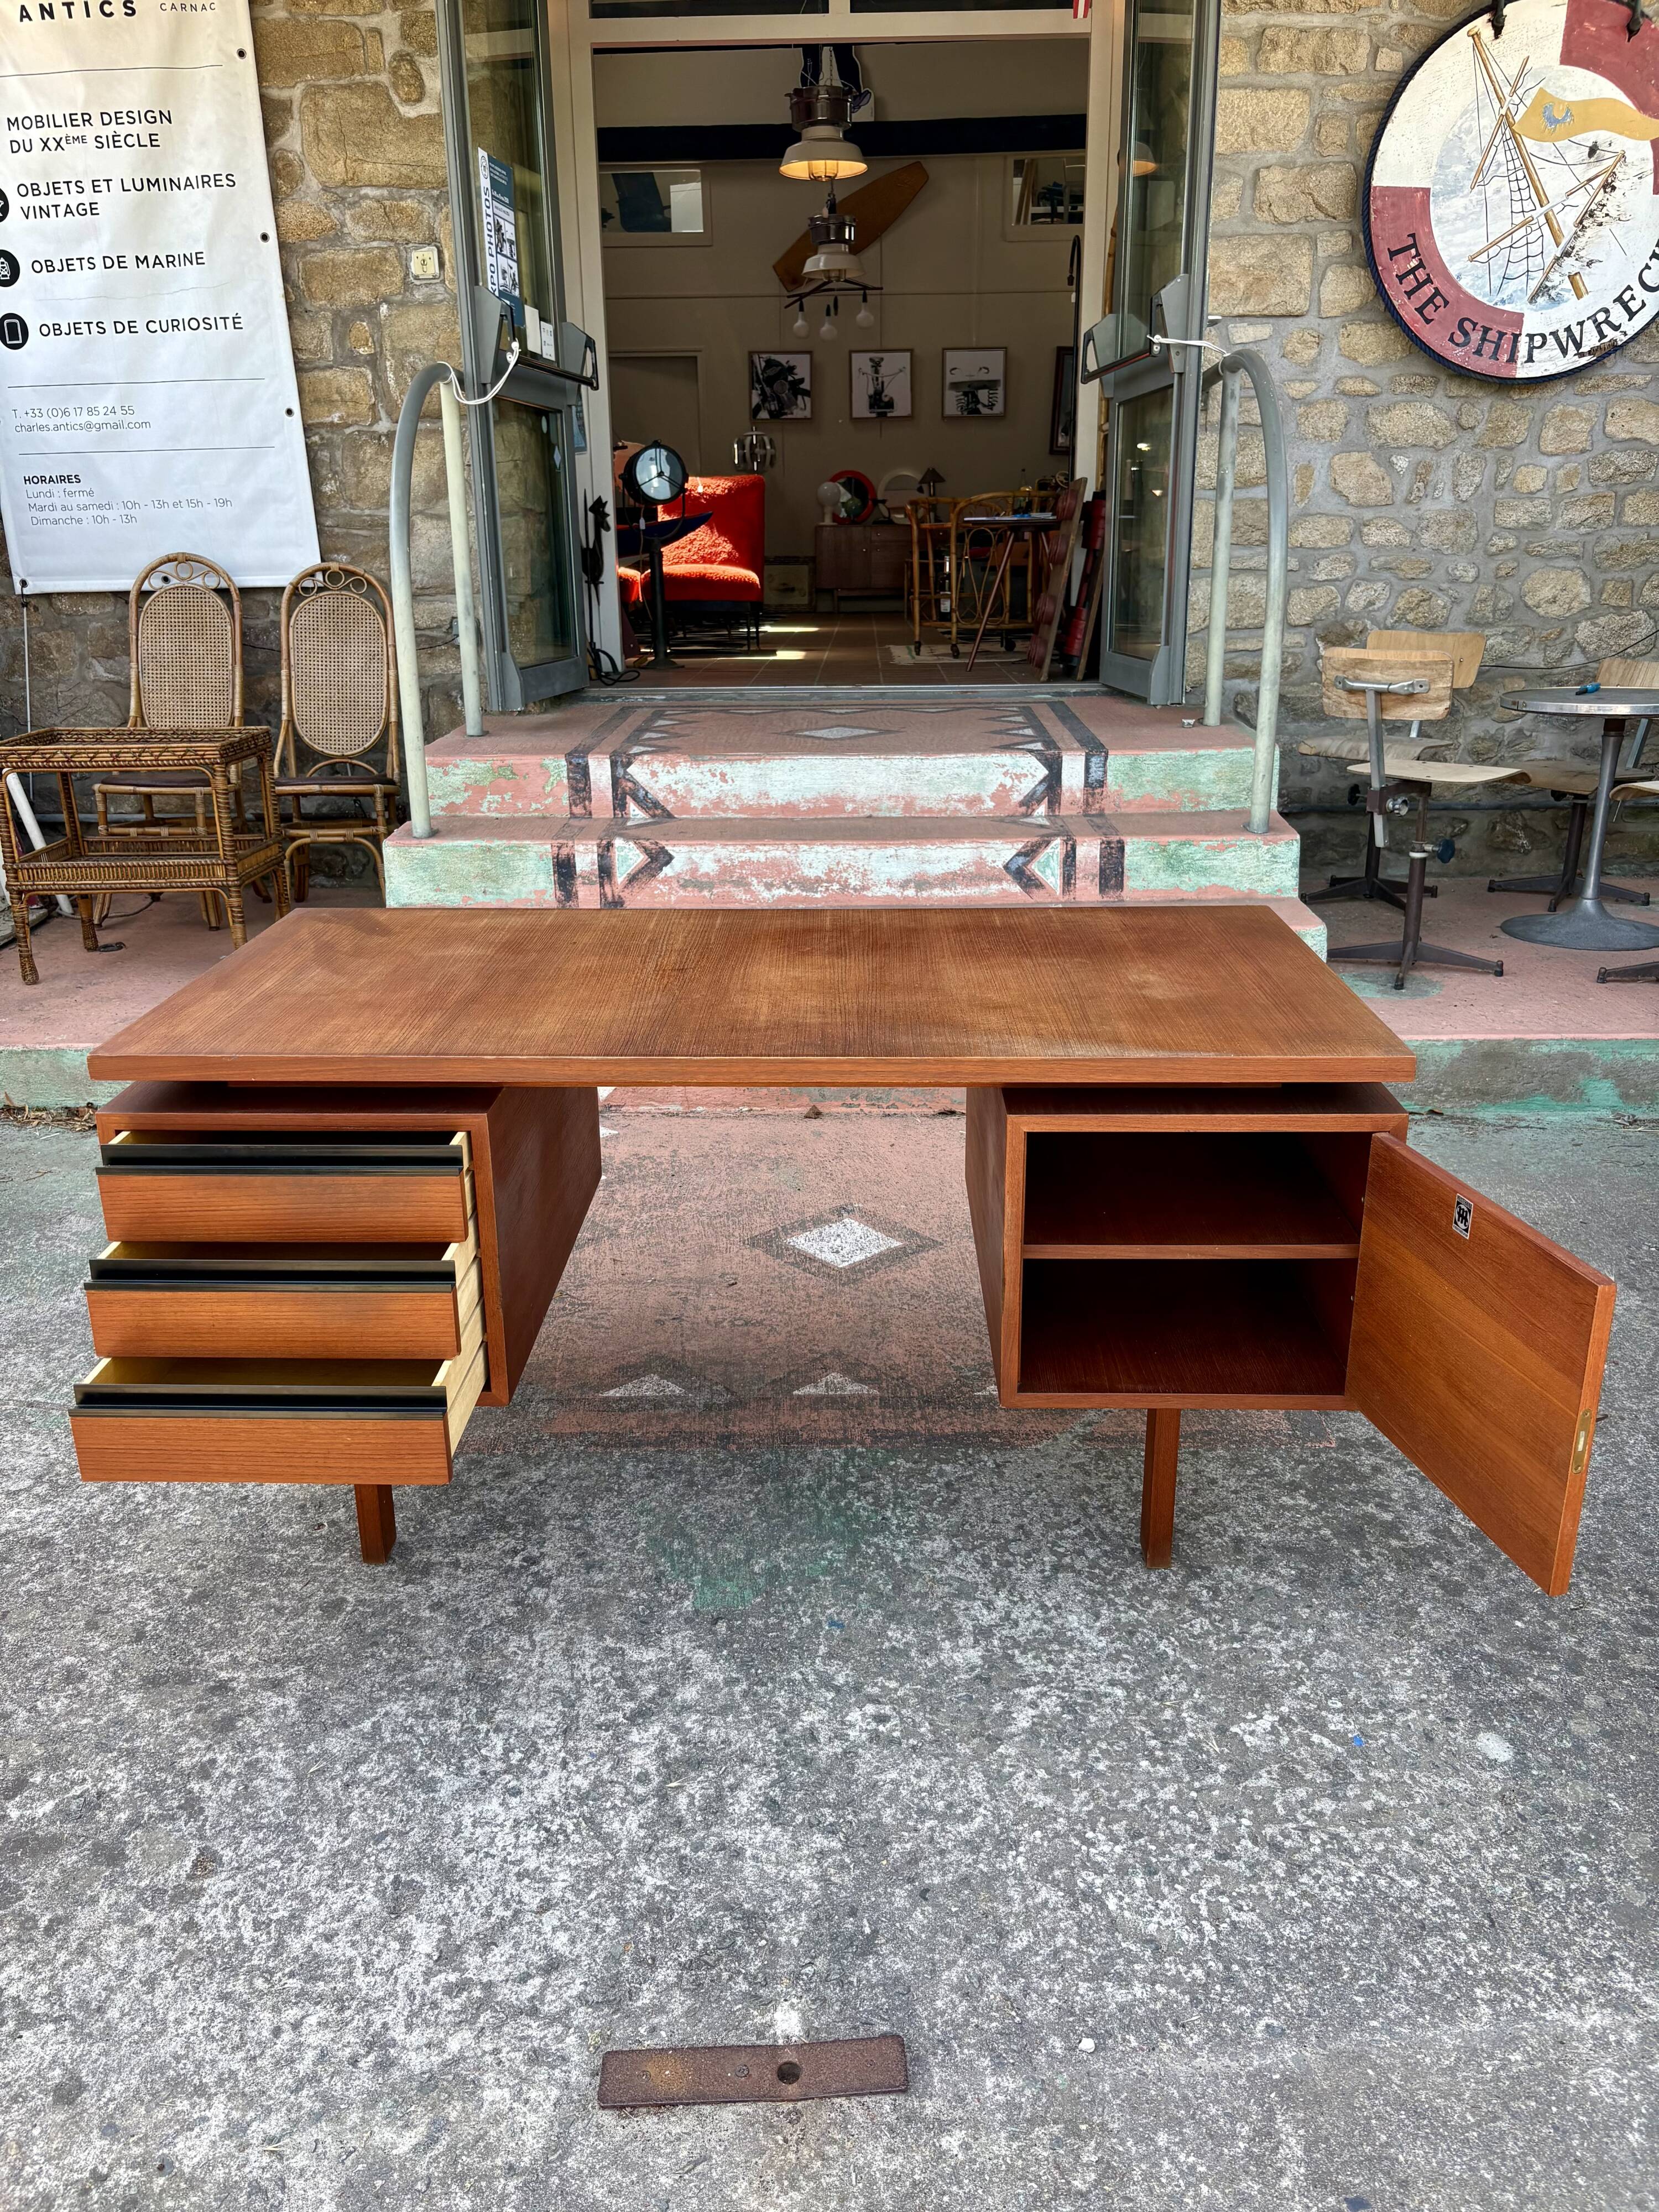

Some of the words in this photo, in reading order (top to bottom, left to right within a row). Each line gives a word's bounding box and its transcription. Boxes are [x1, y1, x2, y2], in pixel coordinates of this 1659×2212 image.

[19, 0, 137, 22] ANTICS
[160, 2, 216, 12] CARNAC
[7, 112, 93, 131] MOBILIER
[100, 109, 173, 127] DESIGN
[9, 139, 33, 154] DU
[95, 131, 160, 149] SIÈCLE
[17, 180, 85, 197] OBJETS
[92, 179, 113, 194] ET
[121, 173, 236, 192] LUMINAIRES
[20, 202, 100, 220] VINTAGE
[483, 186, 495, 257] PHOTOS
[31, 256, 96, 274] OBJETS
[103, 255, 128, 269] DE
[135, 252, 206, 269] MARINE
[1387, 232, 1450, 325] THE
[39, 321, 106, 337] OBJETS
[113, 320, 138, 335] DE
[145, 312, 243, 333] CURIOSITÉ
[12, 409, 22, 419] T.
[24, 408, 43, 419] +33
[46, 407, 71, 419] (0)6
[73, 407, 83, 417] 17
[87, 406, 100, 416] 85
[103, 406, 117, 416] 24
[121, 405, 135, 415] 55
[14, 420, 151, 433] charles.antics@gmail.com
[23, 474, 81, 485] HORAIRES
[26, 489, 55, 499] Lundi
[63, 488, 95, 498] fermé
[28, 502, 57, 512] Mardi
[76, 501, 114, 511] samedi
[122, 500, 141, 510] 10h
[151, 499, 170, 509] 13h
[173, 500, 183, 508] et
[186, 499, 204, 508] 15h
[214, 498, 233, 508] 19h
[31, 515, 83, 525] Dimanche
[92, 515, 110, 524] 10h
[119, 514, 138, 524] 13h
